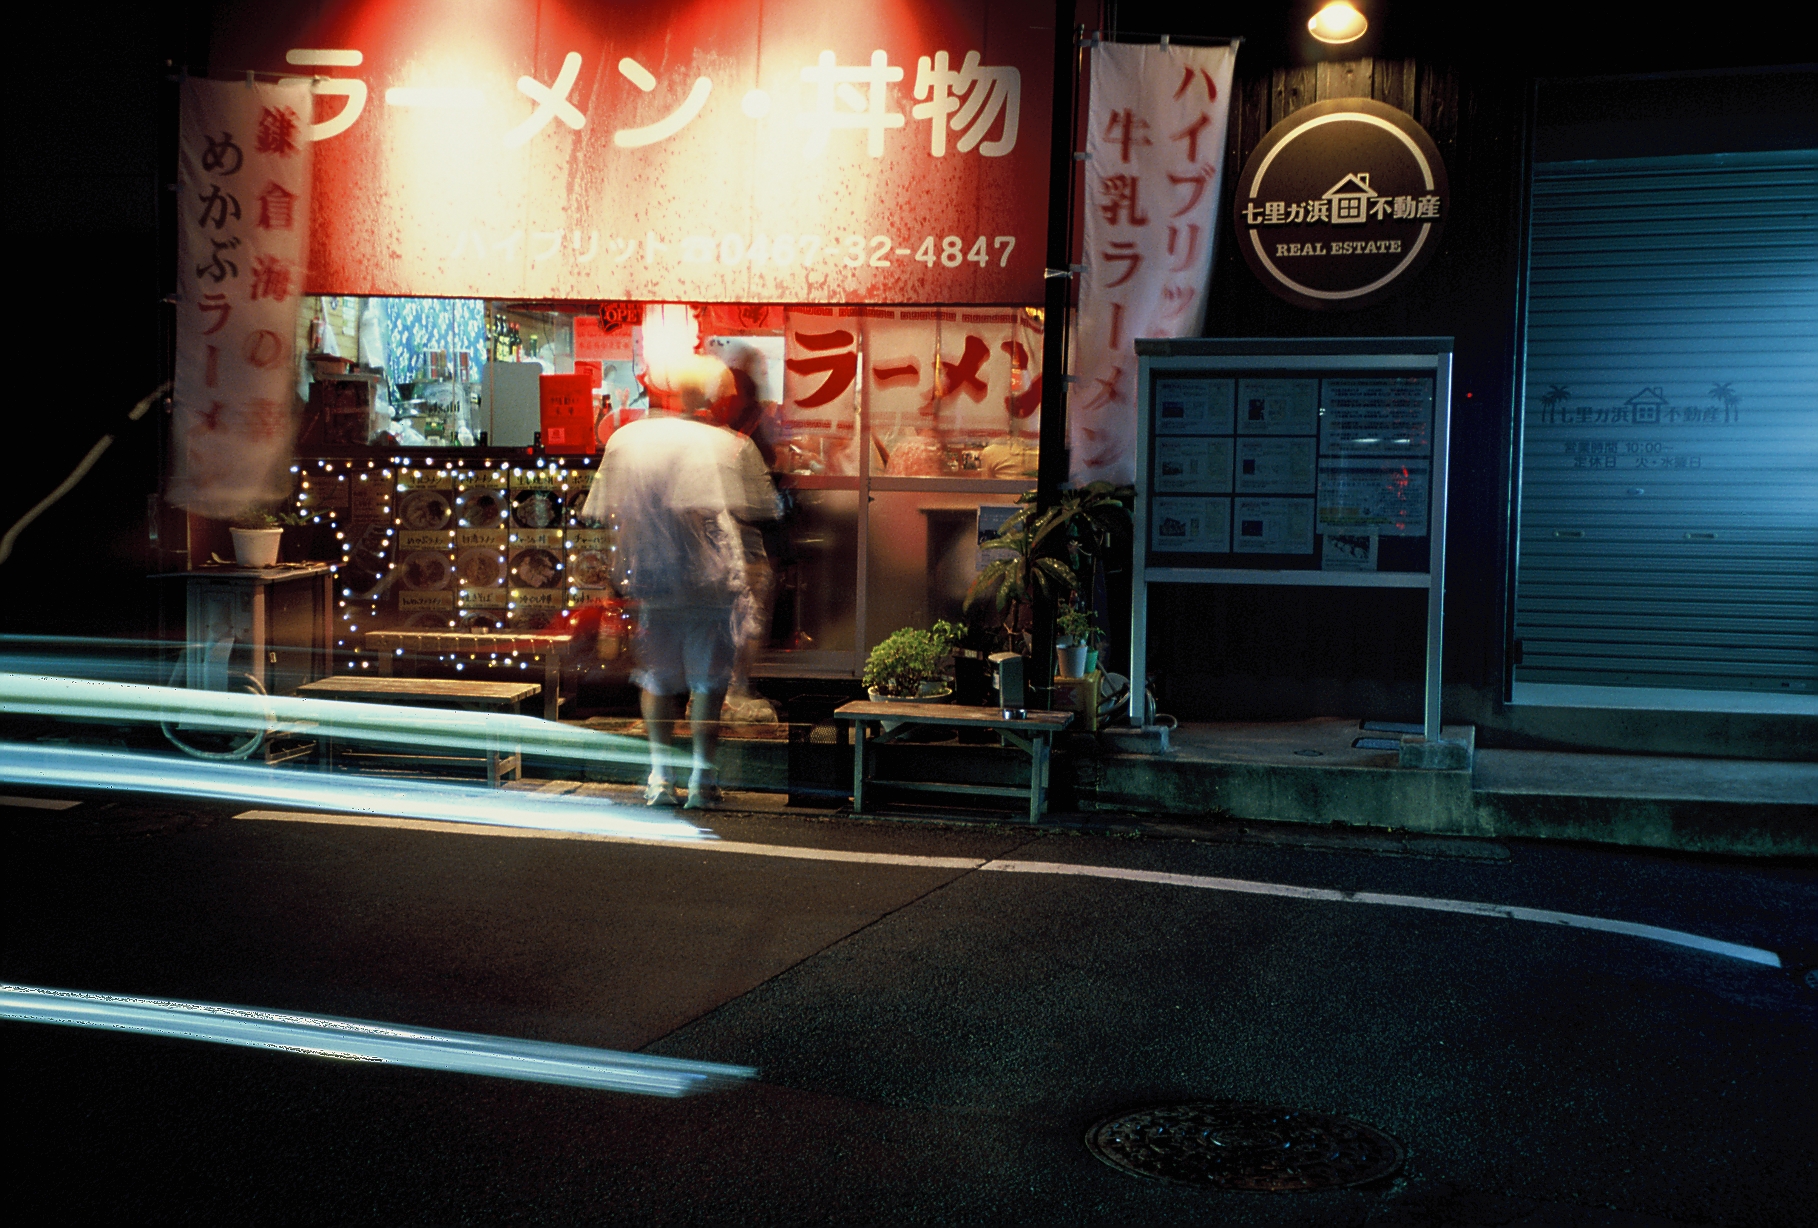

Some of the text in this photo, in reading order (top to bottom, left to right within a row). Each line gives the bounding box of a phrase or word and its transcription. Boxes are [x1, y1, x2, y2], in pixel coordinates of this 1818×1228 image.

[278, 48, 1021, 158] ラーメン・丼物
[1147, 66, 1217, 338] ハイブリッ
[1241, 195, 1441, 225] 七里ガ浜 不動産
[720, 233, 1016, 269] 0467-32-4847
[1276, 240, 1402, 257] REAL ESTATE
[606, 309, 643, 322] OPE
[1082, 107, 1151, 468] 牛乳ラーメン
[786, 329, 1044, 420] ラーメン
